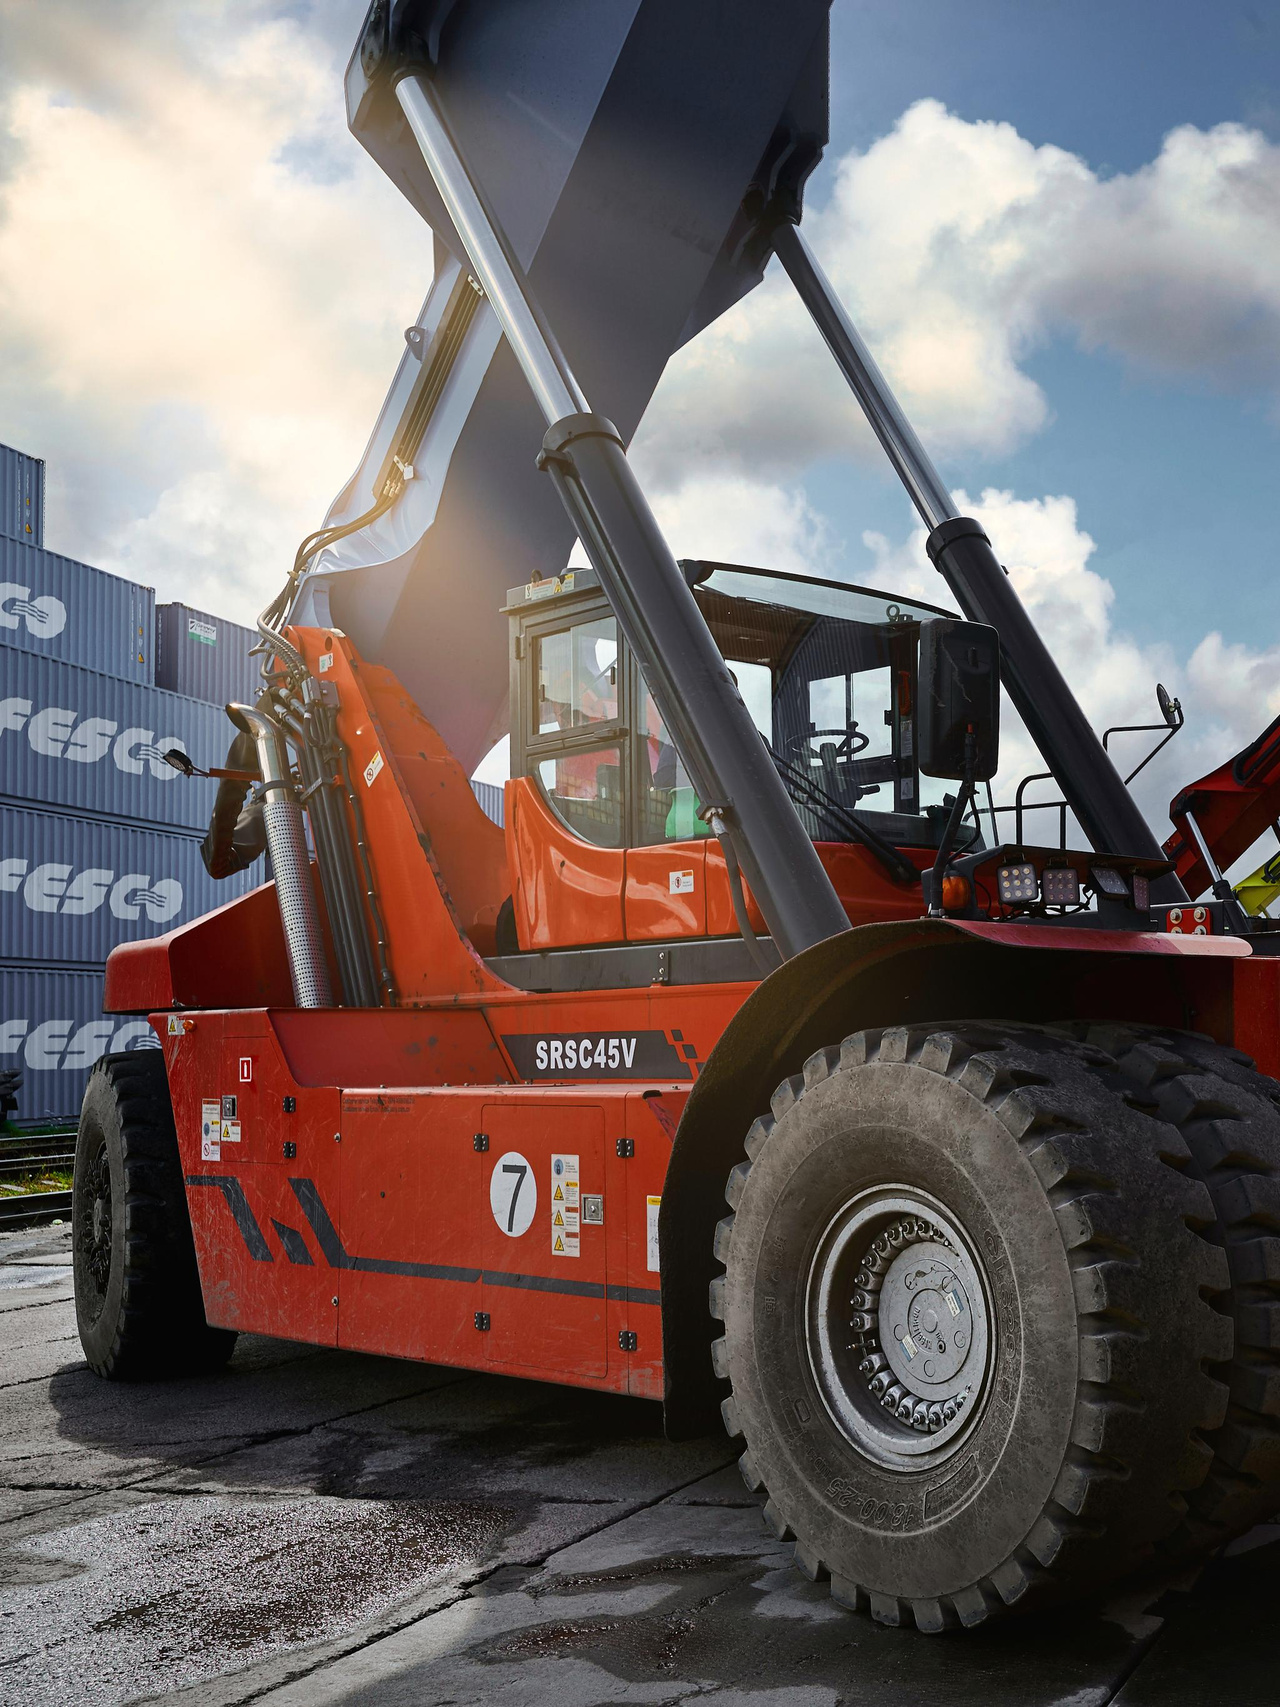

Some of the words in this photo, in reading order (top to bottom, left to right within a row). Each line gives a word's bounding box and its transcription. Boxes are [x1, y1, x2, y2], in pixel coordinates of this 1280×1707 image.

[0, 697, 187, 780] FESCO
[0, 858, 183, 923] FESCO
[0, 1019, 162, 1070] FESC
[535, 1038, 637, 1070] SRSC45V
[502, 1164, 527, 1232] 7
